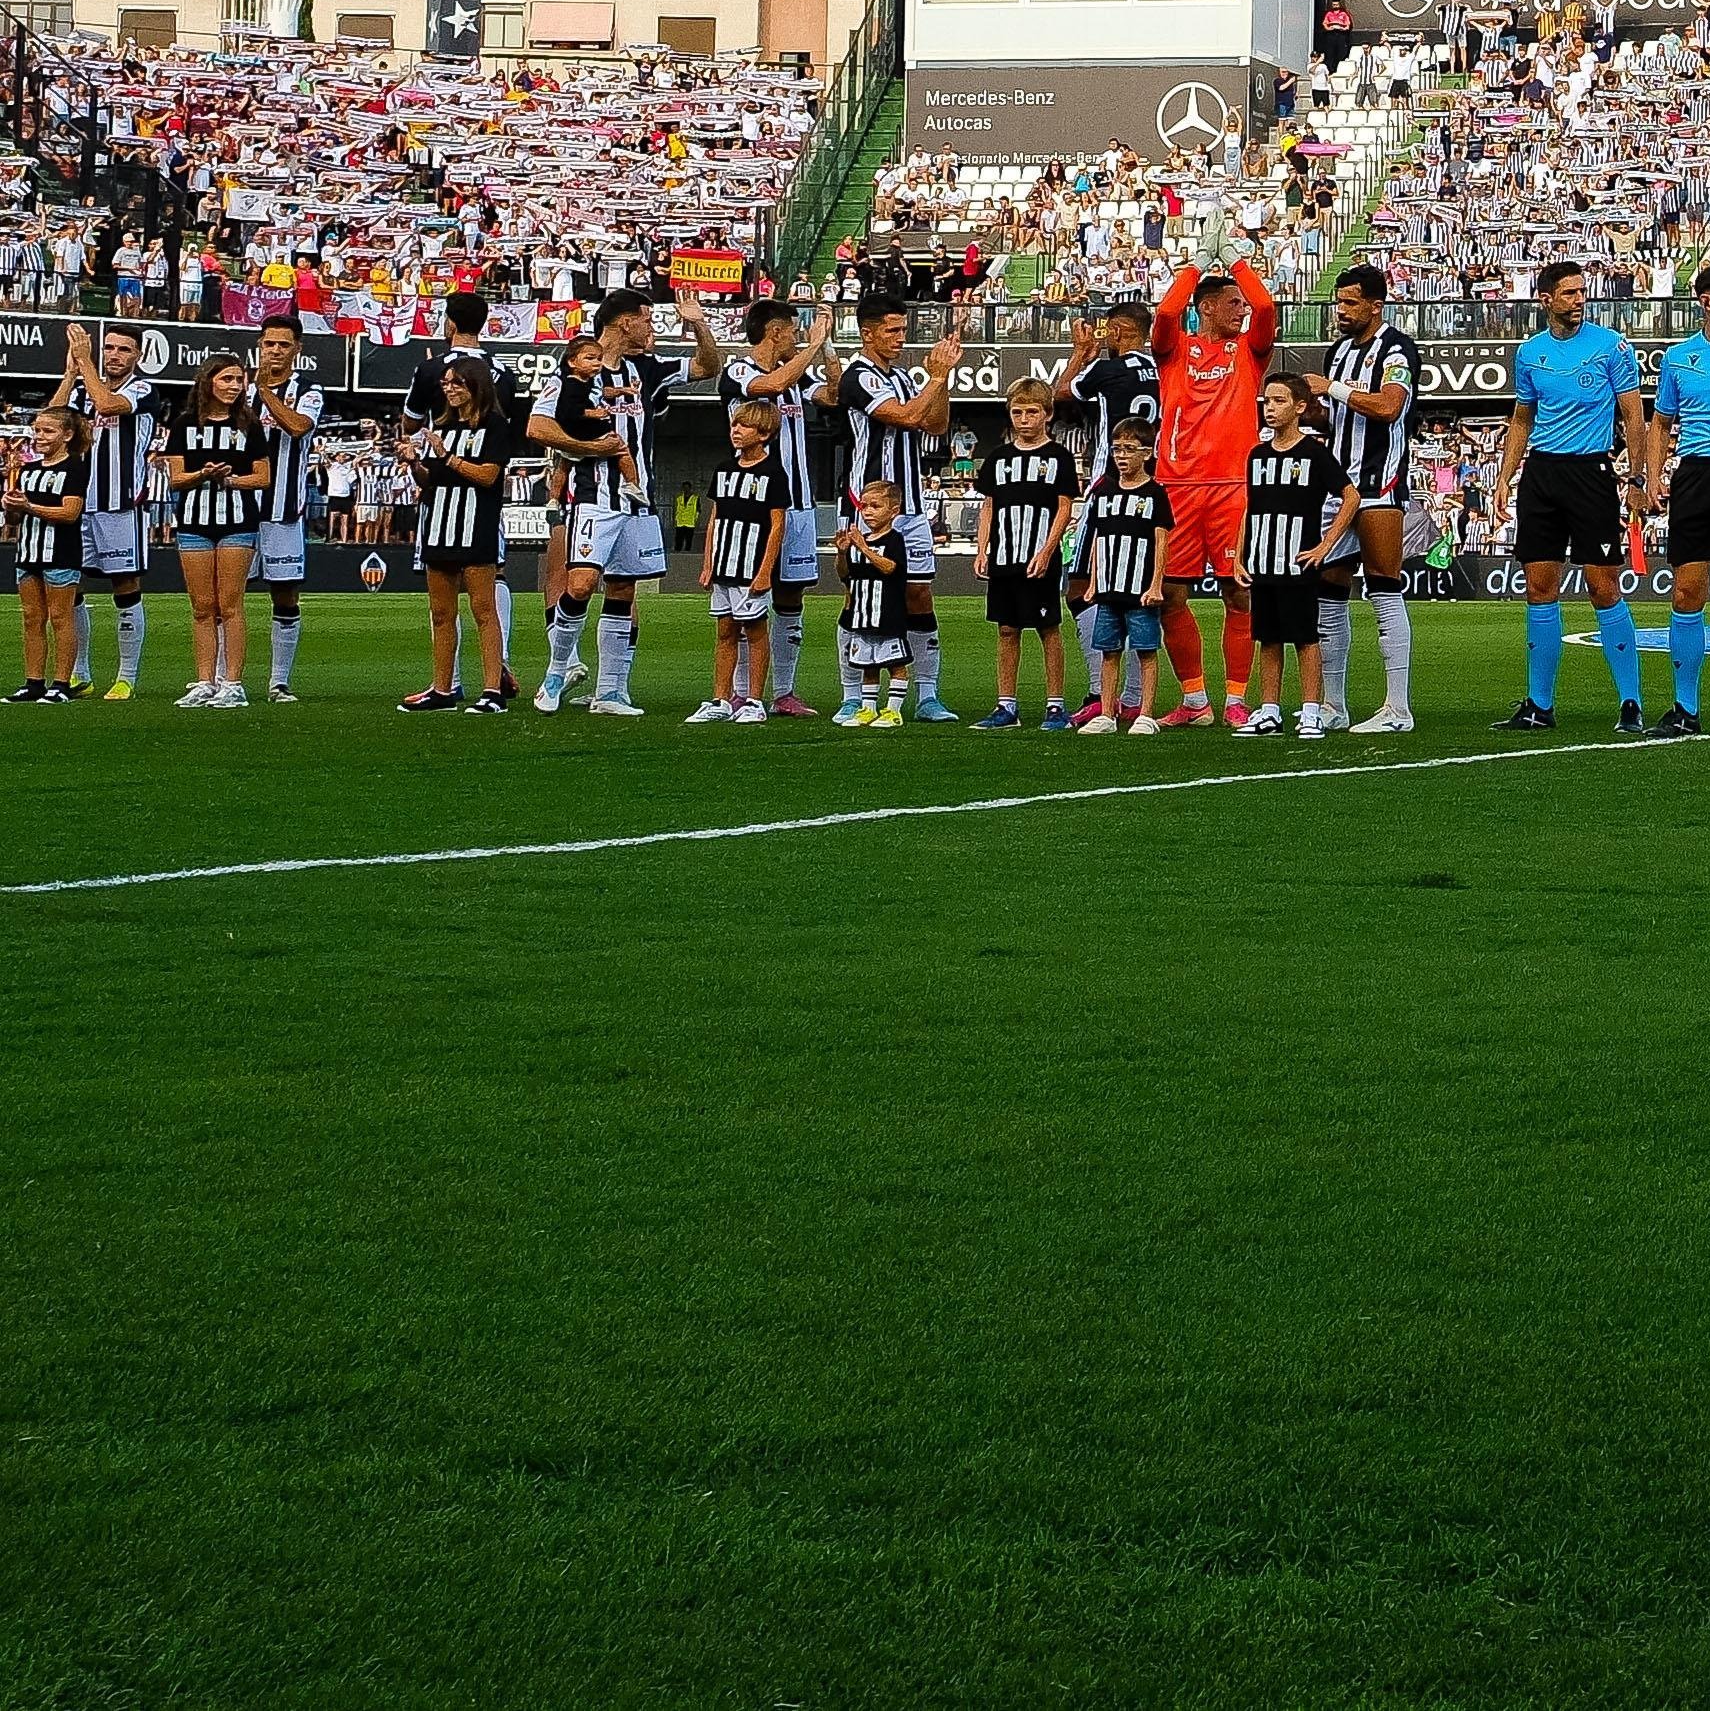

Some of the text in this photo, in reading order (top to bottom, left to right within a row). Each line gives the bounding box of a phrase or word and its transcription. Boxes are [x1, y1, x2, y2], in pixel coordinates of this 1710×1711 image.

[925, 89, 1056, 107] Mercedes-Benz
[924, 115, 993, 131] Autocas
[1012, 152, 1100, 165] Mercedes-Ben
[672, 259, 741, 280] Albacete
[580, 518, 594, 540] 4
